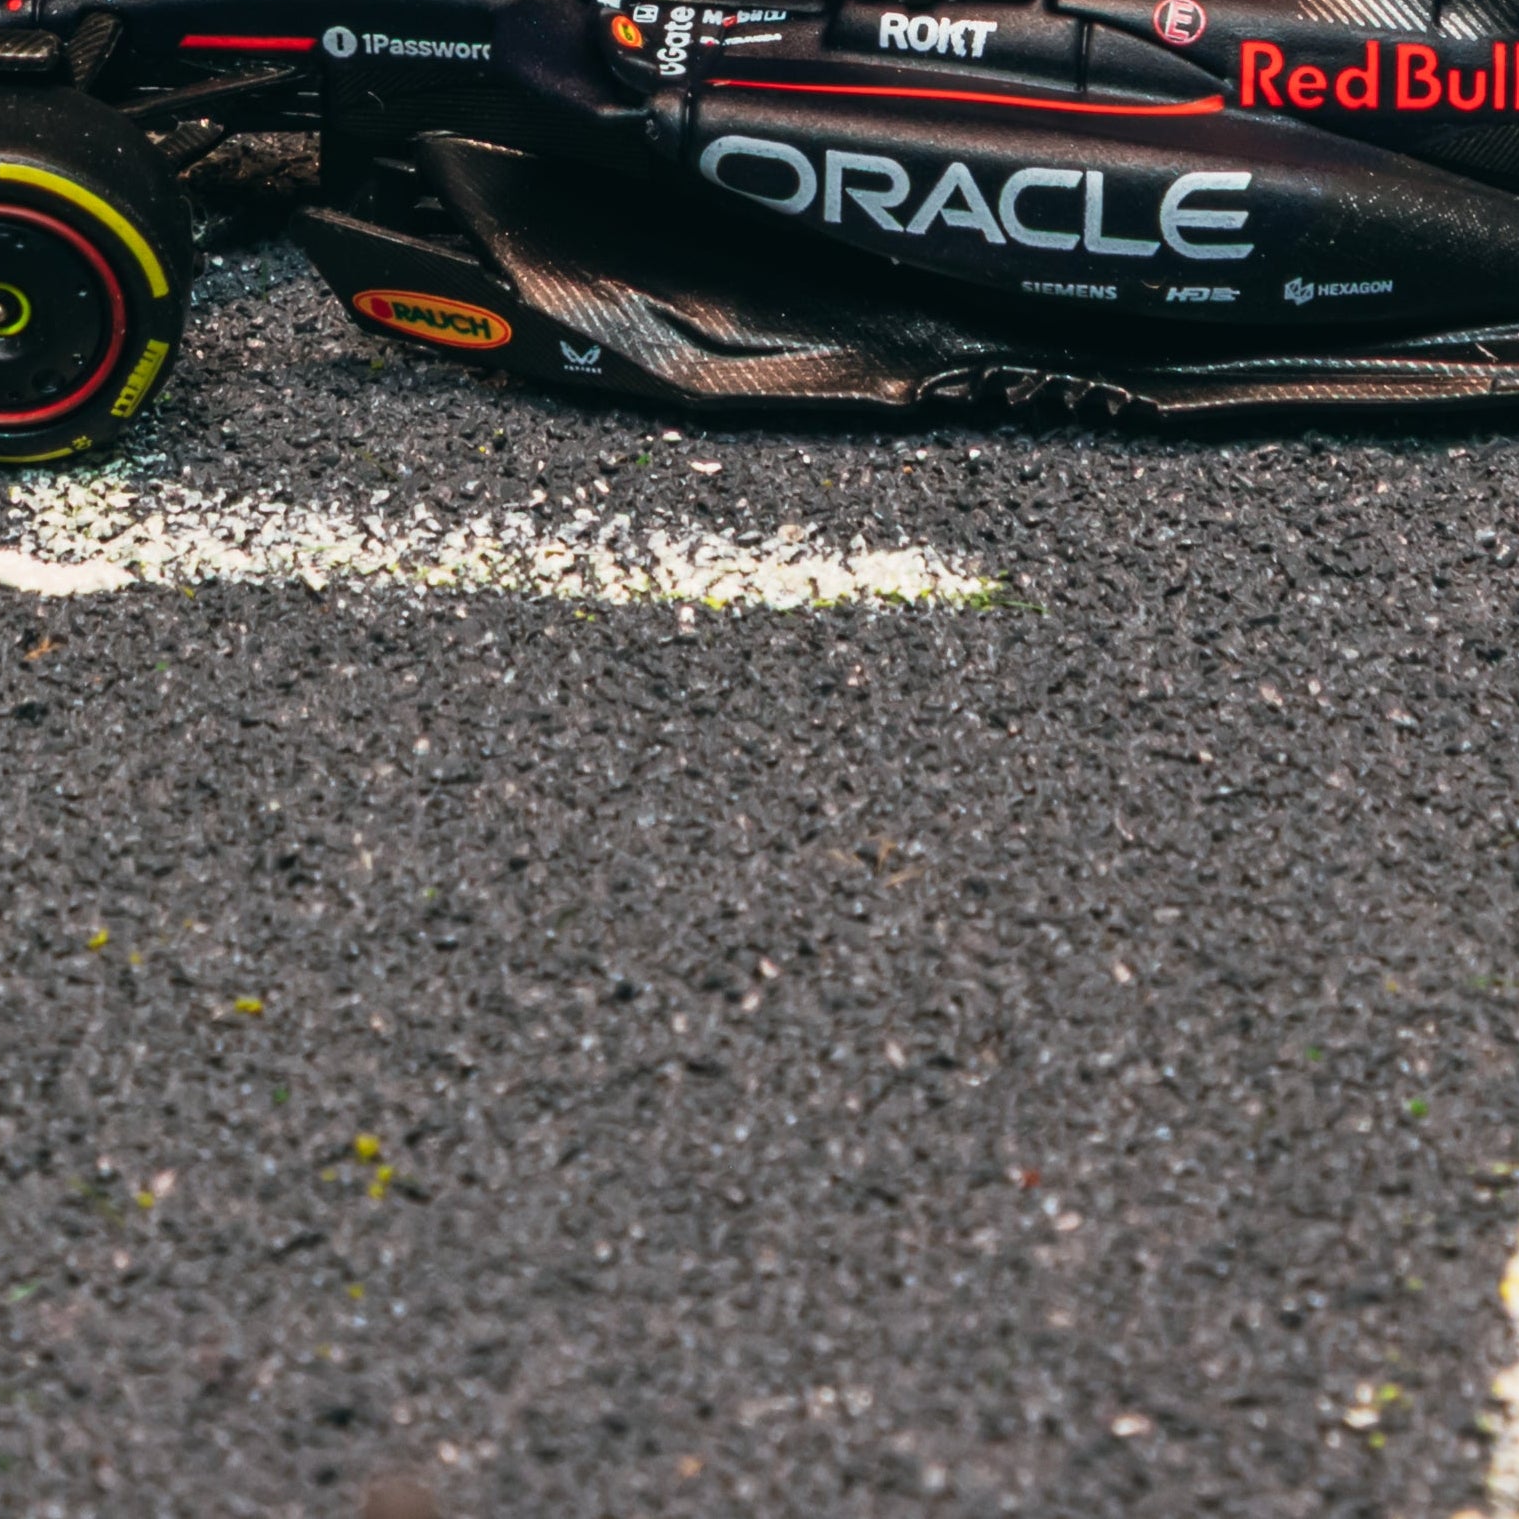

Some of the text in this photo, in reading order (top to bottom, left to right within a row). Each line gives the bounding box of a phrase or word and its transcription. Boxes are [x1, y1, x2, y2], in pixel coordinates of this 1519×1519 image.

[880, 12, 998, 58] ROKT
[1240, 40, 1379, 110] Red
[699, 135, 1255, 260] ORACLE
[1021, 280, 1118, 300] SIEMENS
[1318, 279, 1394, 297] HEXAGON
[391, 301, 493, 341] RAUCH
